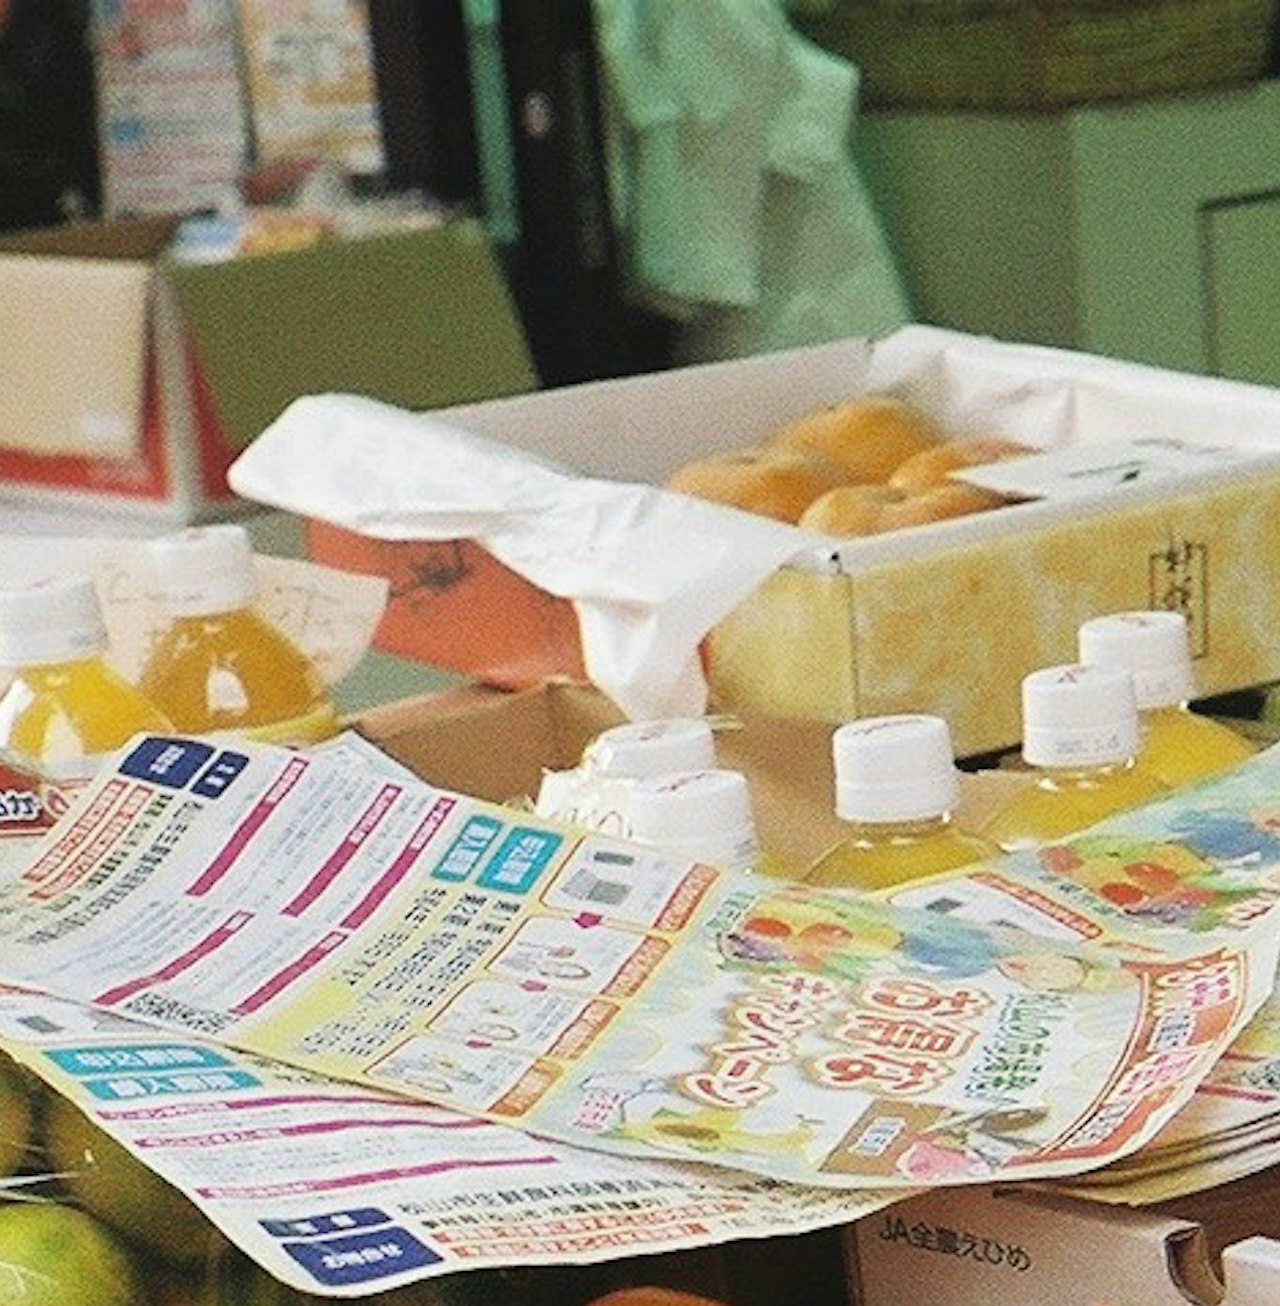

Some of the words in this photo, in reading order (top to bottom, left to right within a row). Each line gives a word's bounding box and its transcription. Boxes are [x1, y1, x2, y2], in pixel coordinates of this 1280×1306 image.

[879, 1215, 1031, 1272] JA全農えひめ
